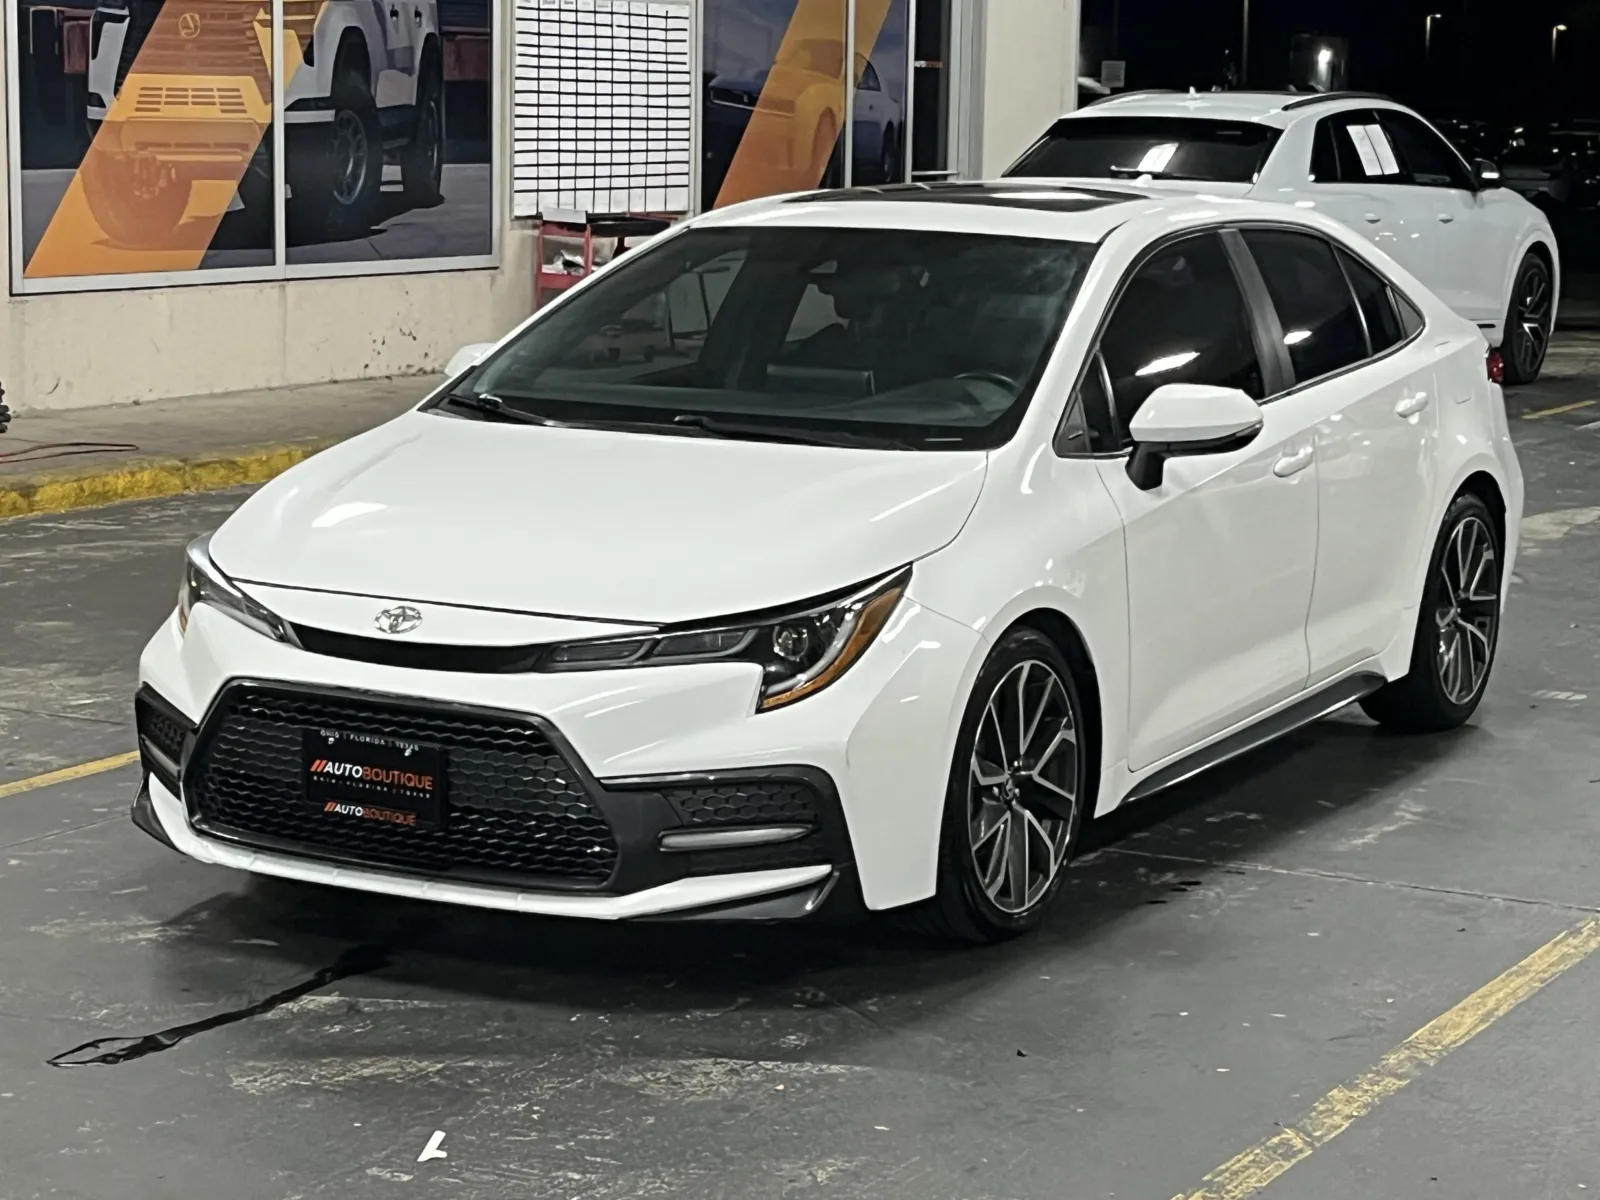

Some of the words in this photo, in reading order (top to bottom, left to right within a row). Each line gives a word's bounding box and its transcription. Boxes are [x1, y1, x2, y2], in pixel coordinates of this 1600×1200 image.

[350, 734, 386, 746] FLORIDA
[323, 761, 433, 790] AUTOBOUTIQUE
[333, 804, 417, 826] AUTOBOUTIQUE
